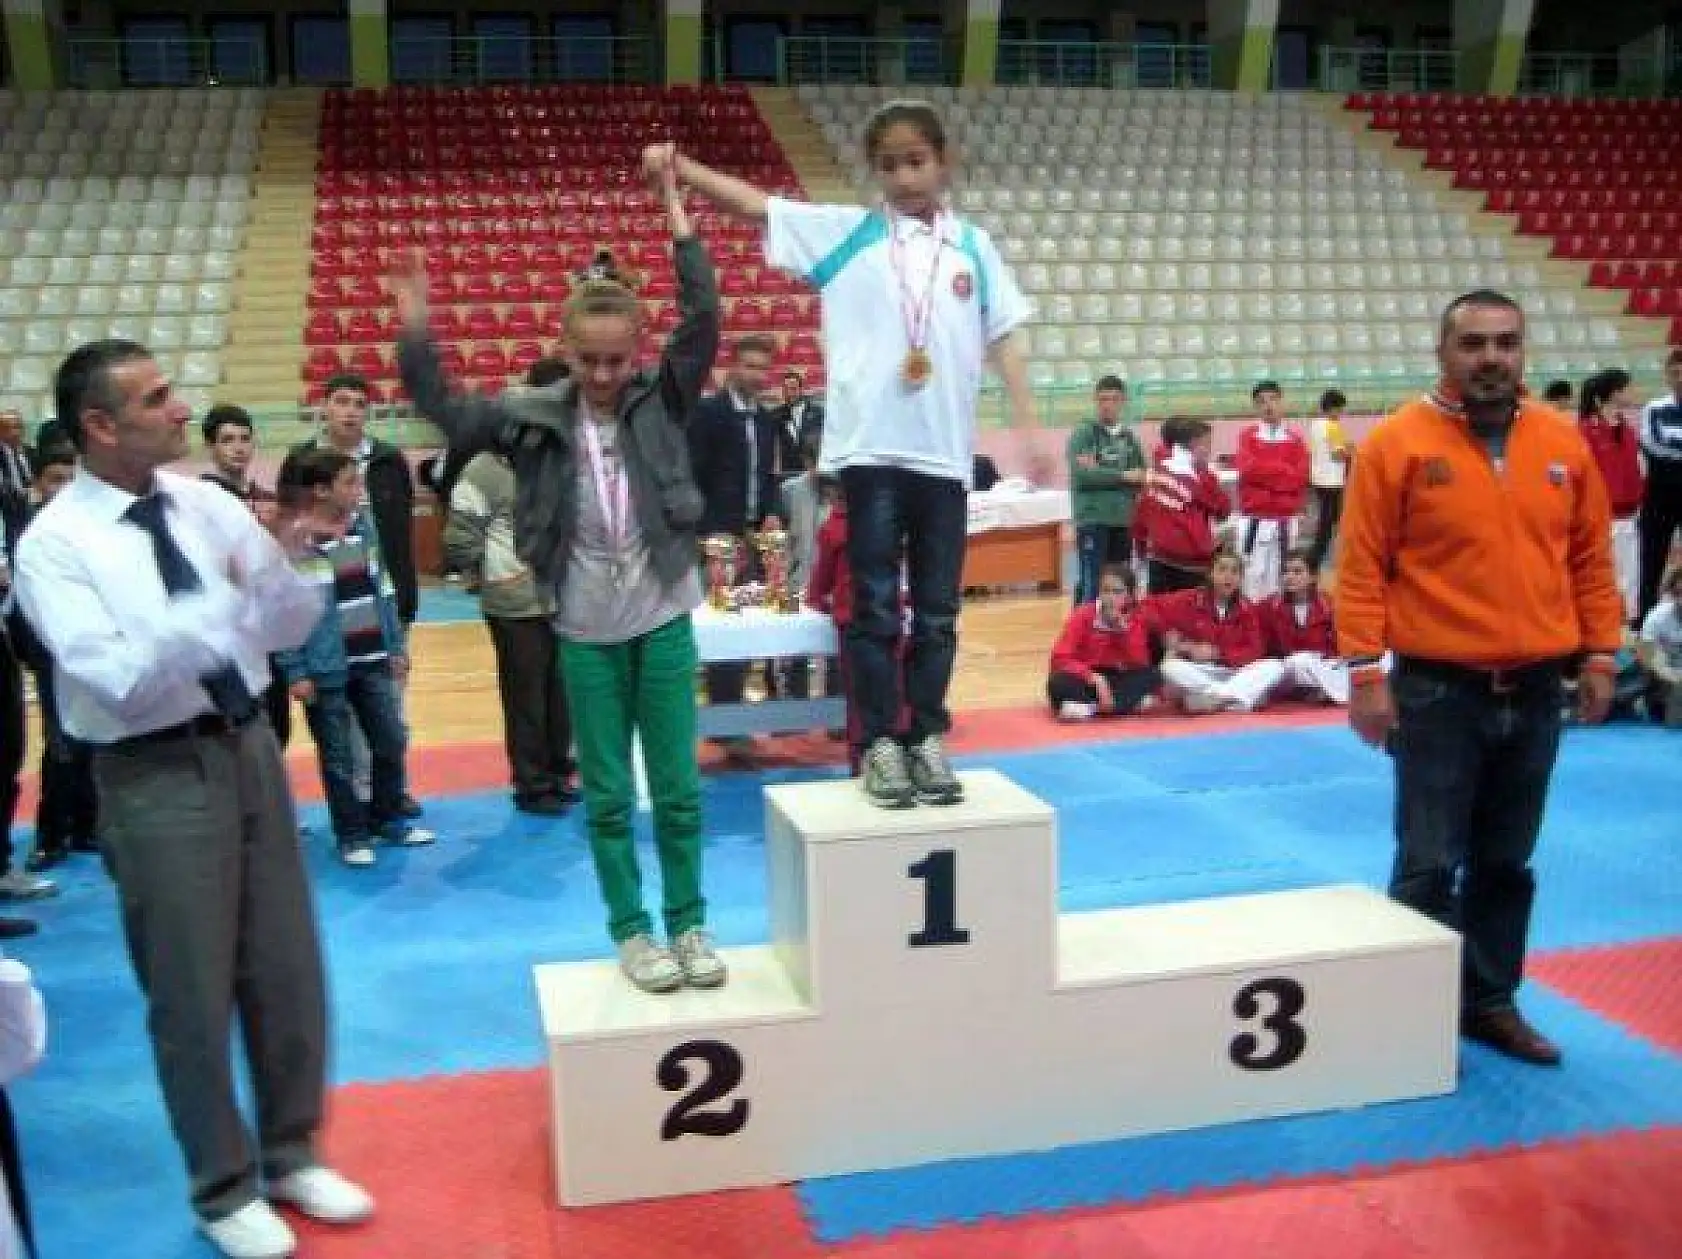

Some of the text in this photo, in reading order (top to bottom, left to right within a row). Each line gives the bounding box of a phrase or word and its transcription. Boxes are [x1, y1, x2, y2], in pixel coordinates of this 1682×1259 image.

[907, 849, 970, 949] 1
[1229, 977, 1307, 1072] 3
[655, 1039, 750, 1142] 2
